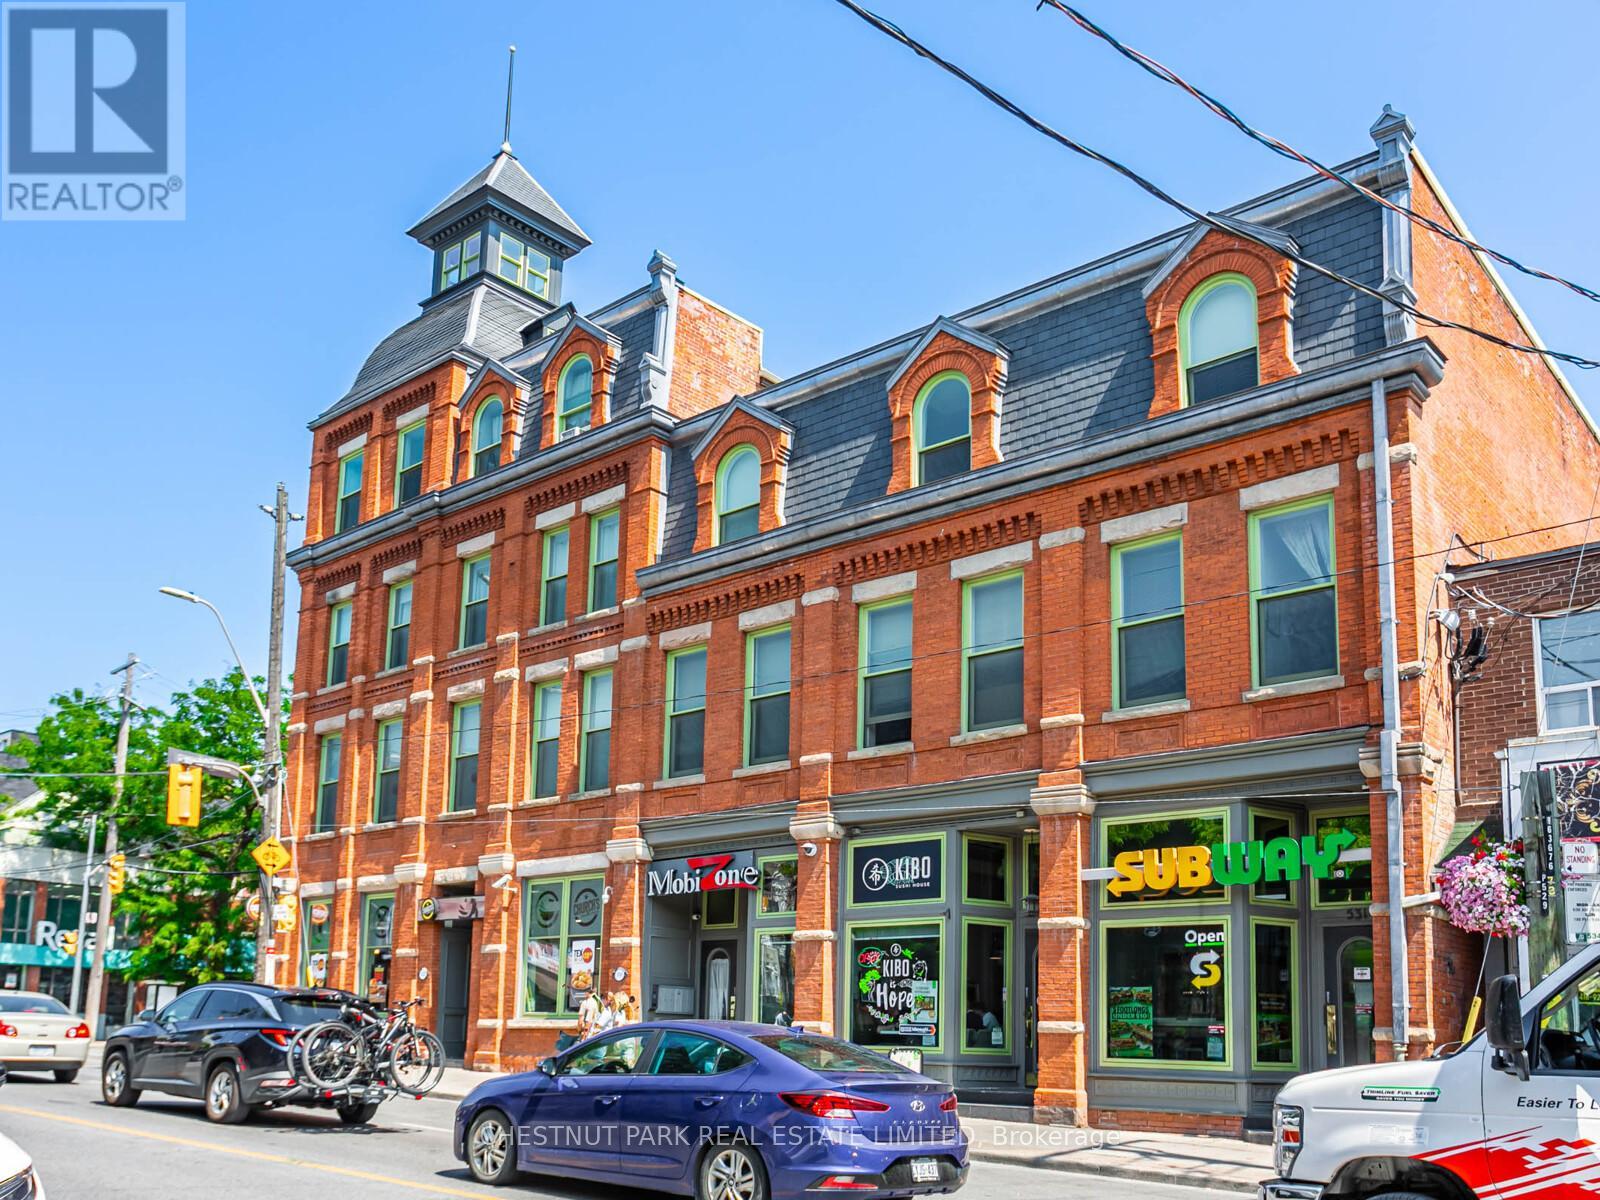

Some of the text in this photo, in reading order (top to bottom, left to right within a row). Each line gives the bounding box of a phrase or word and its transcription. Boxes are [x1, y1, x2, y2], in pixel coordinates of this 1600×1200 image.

[1574, 845, 1586, 854] NO
[895, 856, 931, 880] KIBO
[1106, 828, 1357, 898] SUBWAY
[647, 854, 761, 897] MobiZone
[1184, 929, 1224, 947] Open
[883, 959, 910, 977] KIBO
[876, 982, 914, 1010] Hope
[1517, 1096, 1563, 1109] Easier
[1568, 1097, 1585, 1110] To
